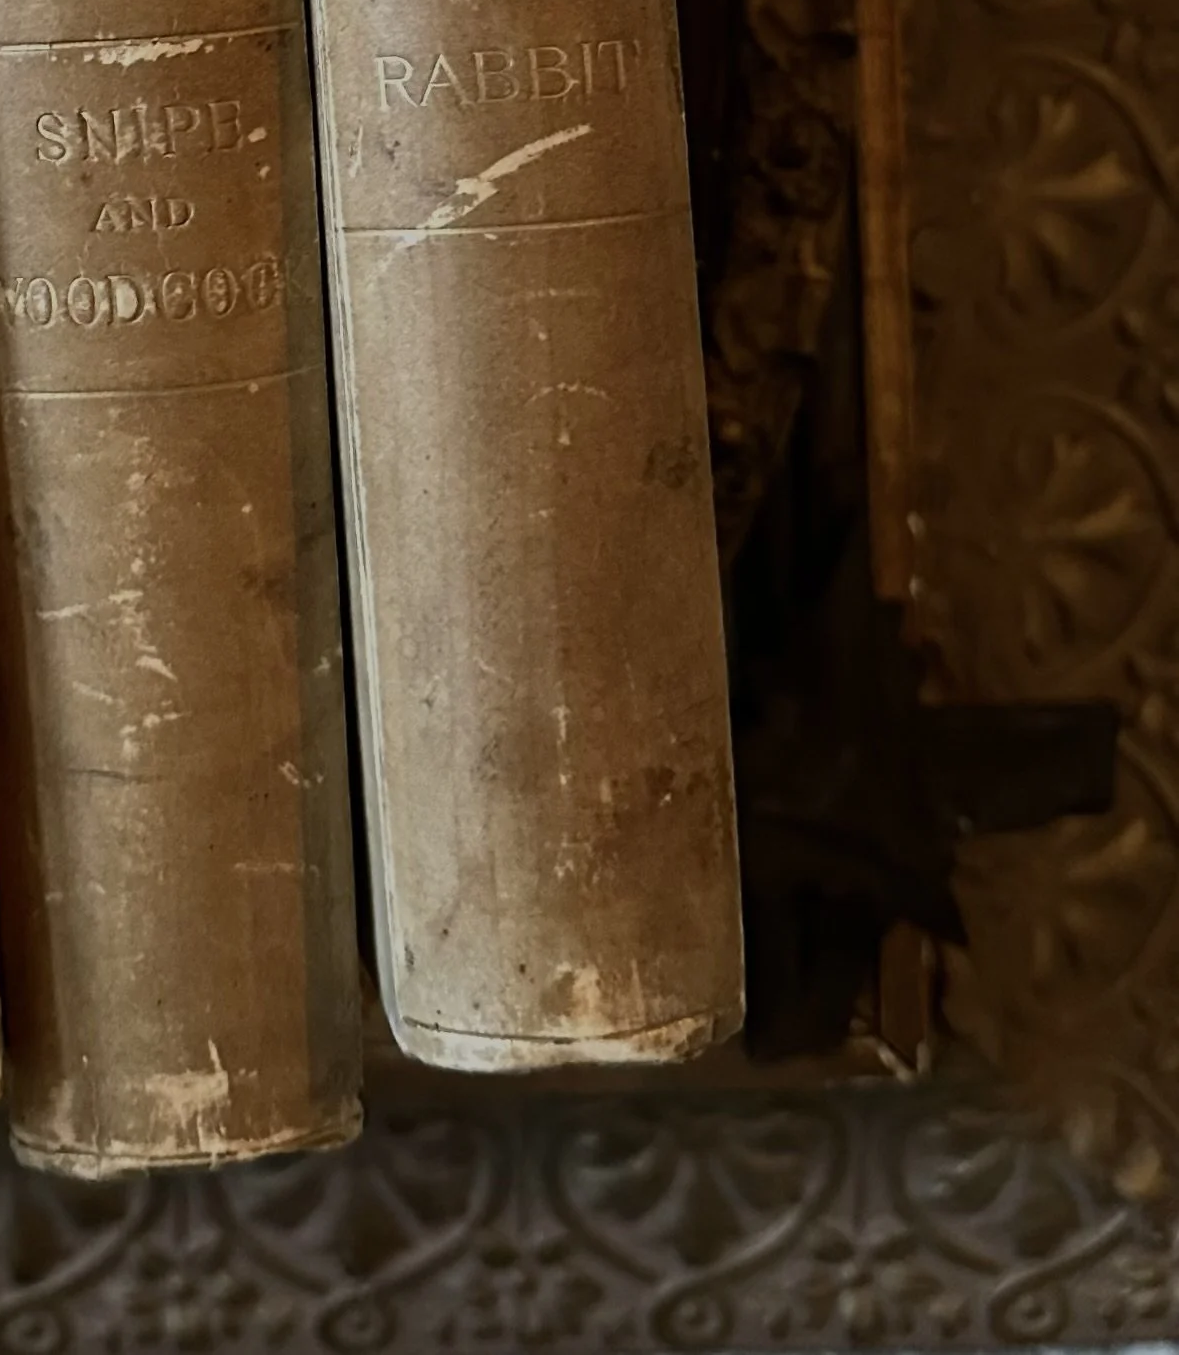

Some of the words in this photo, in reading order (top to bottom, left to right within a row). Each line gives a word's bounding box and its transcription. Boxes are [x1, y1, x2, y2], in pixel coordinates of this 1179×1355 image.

[373, 40, 642, 112] RABBIT
[35, 100, 244, 164] SNIPE
[90, 196, 195, 232] AND
